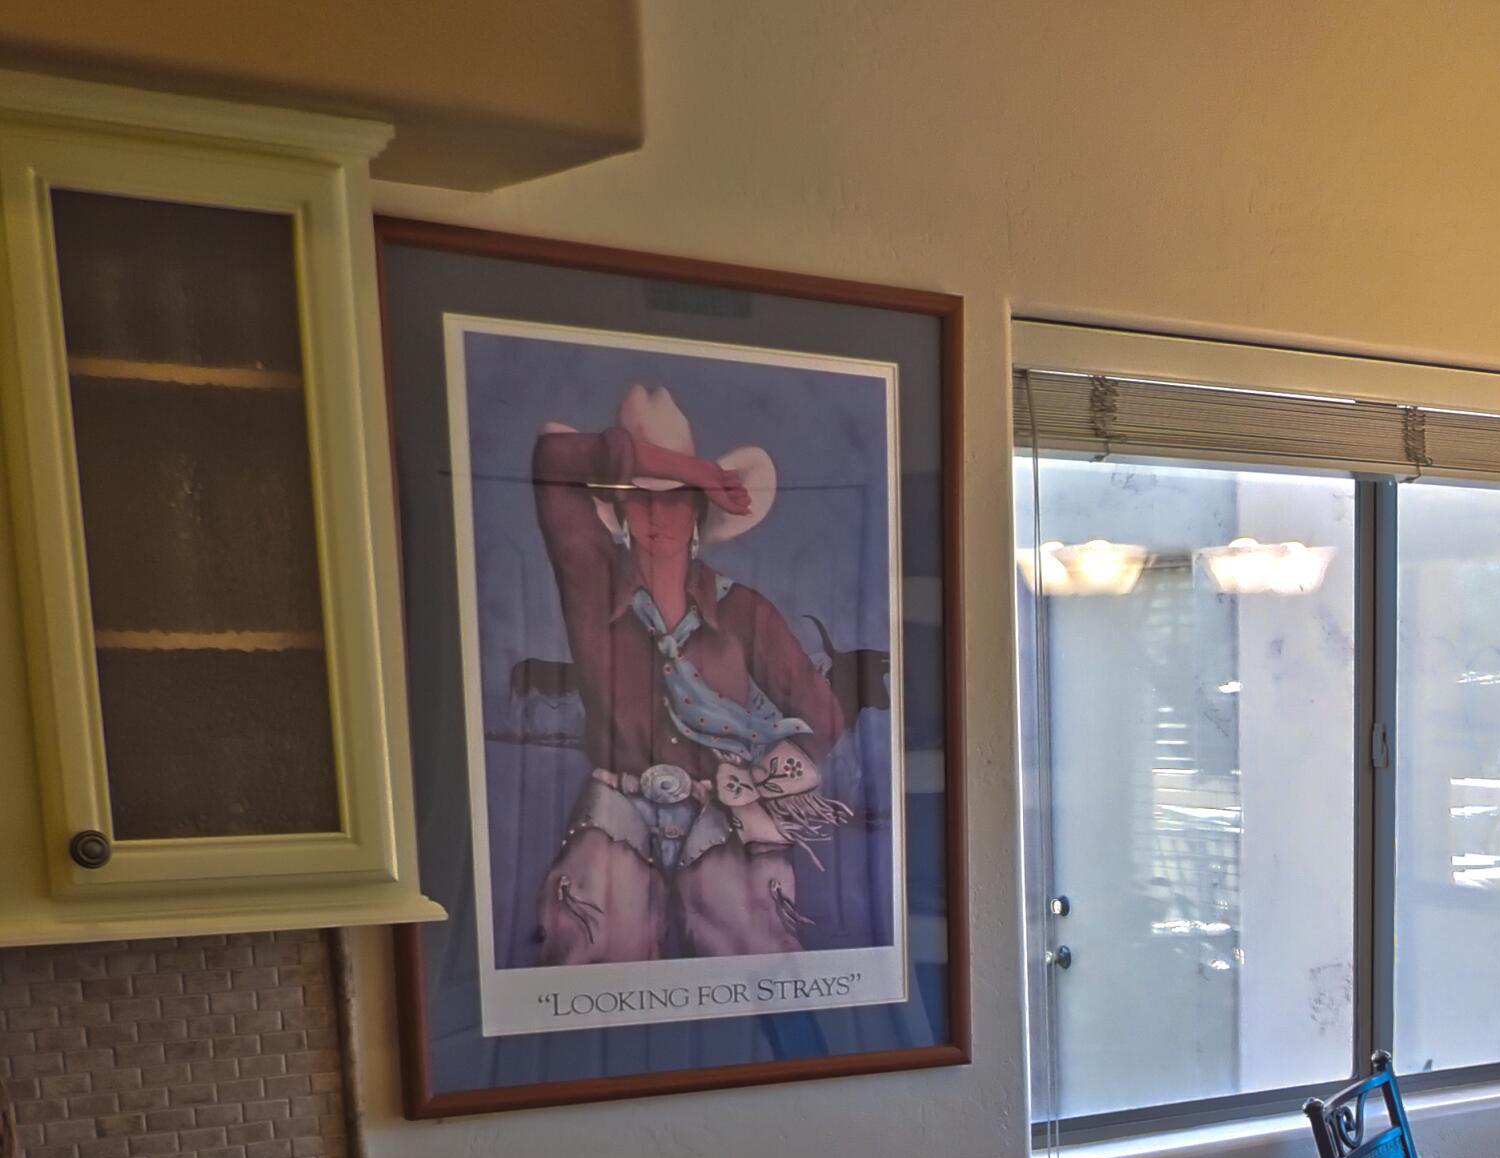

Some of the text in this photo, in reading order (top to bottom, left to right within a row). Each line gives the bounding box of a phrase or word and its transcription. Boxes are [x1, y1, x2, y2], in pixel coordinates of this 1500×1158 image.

[537, 973, 862, 1016] “LOOKING FOR STRAYS”
